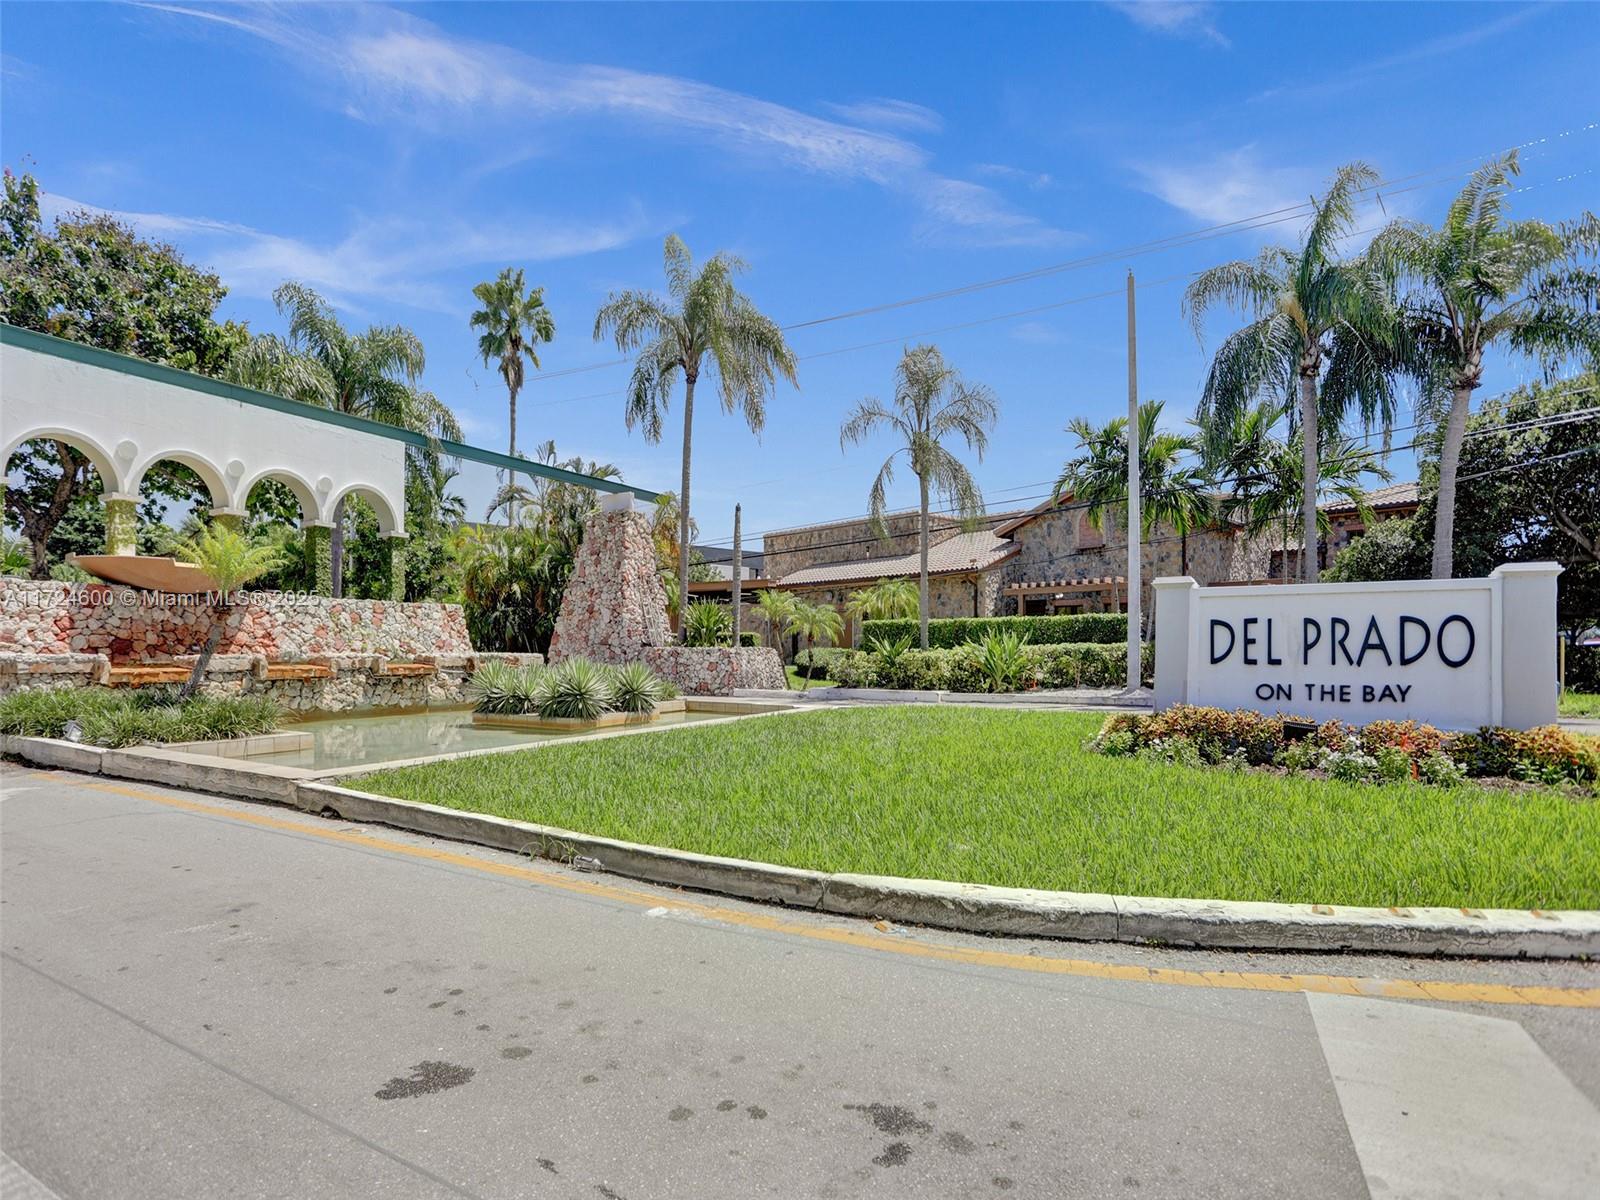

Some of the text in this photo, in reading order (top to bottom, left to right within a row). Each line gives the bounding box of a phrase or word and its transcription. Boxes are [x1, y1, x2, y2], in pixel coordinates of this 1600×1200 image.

[1209, 614, 1476, 669] DEL PRADO
[1255, 683, 1412, 703] ON THE BAY
